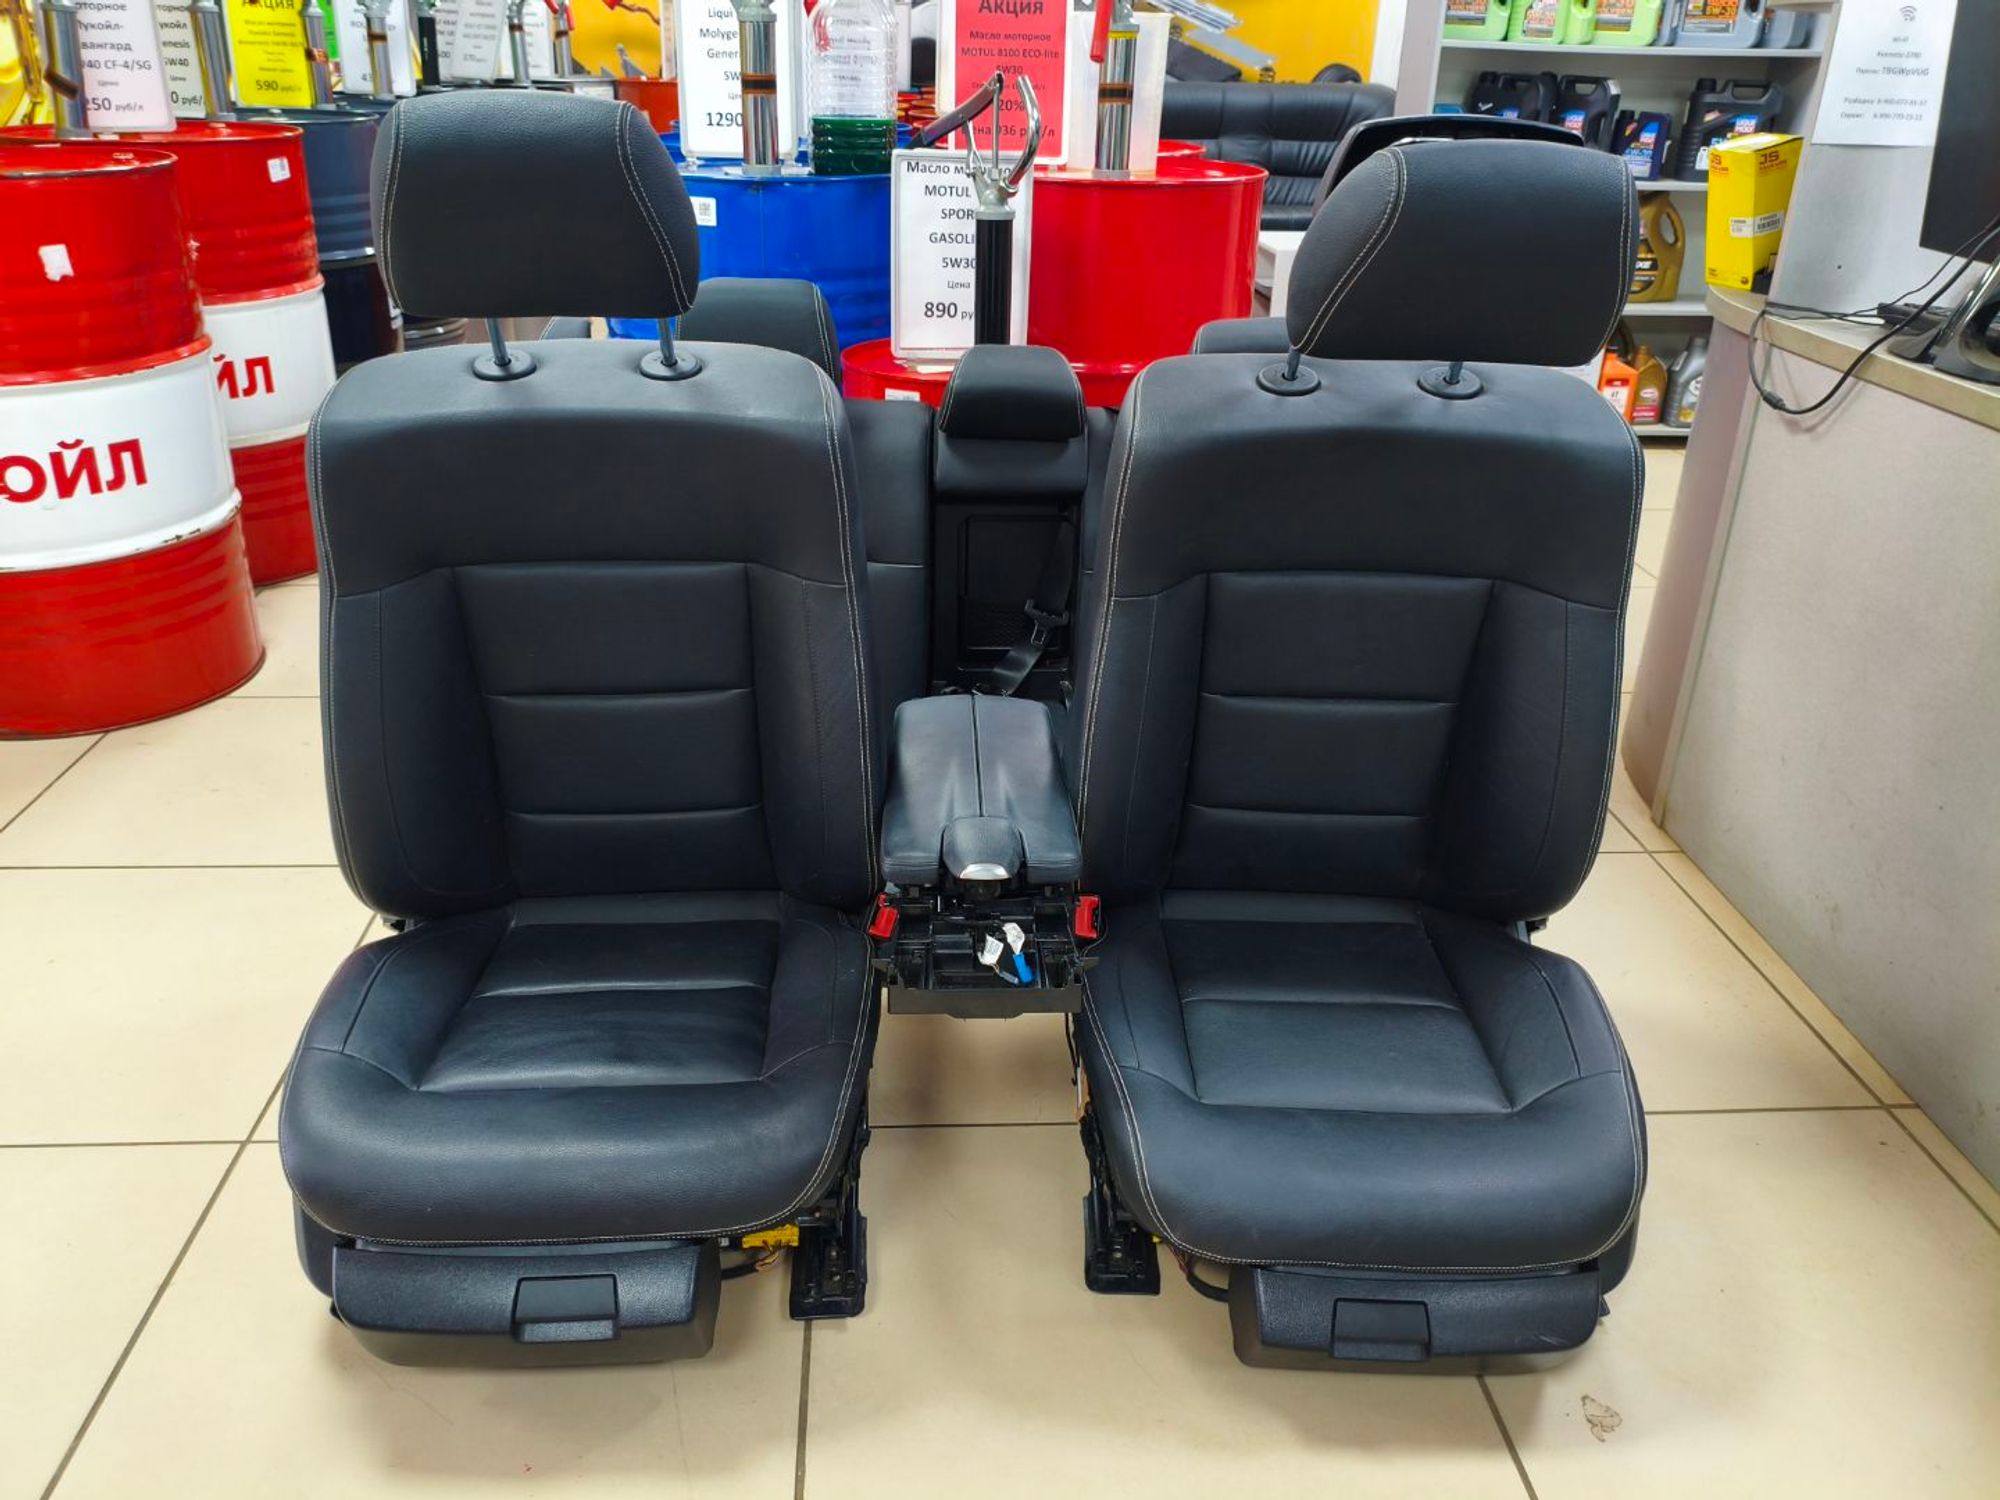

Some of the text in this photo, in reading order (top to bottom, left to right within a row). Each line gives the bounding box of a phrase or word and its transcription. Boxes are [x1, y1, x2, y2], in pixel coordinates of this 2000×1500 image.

[75, 1, 128, 11] оторное
[157, 3, 190, 12] торно
[978, 0, 1044, 17] Акция
[708, 8, 734, 20] Liqui
[159, 19, 188, 30] укойл
[699, 27, 739, 40] Molyge
[969, 30, 1052, 42] Масло моторное
[80, 41, 133, 52] вангард
[162, 39, 191, 49] enesis
[706, 48, 740, 59] Gener
[960, 47, 995, 57] MOTUL
[1022, 48, 1060, 59] ECO-lite
[723, 71, 742, 81] 5W
[255, 79, 279, 92] 590
[1759, 150, 1780, 163] JS
[906, 161, 950, 175] Масло
[924, 184, 972, 198] MOTUL
[940, 208, 975, 220] SPOR
[929, 231, 976, 245] GASOLI
[947, 279, 971, 289] Цена
[923, 301, 975, 322] 890 ру
[0, 438, 148, 503] ОЙЛ
